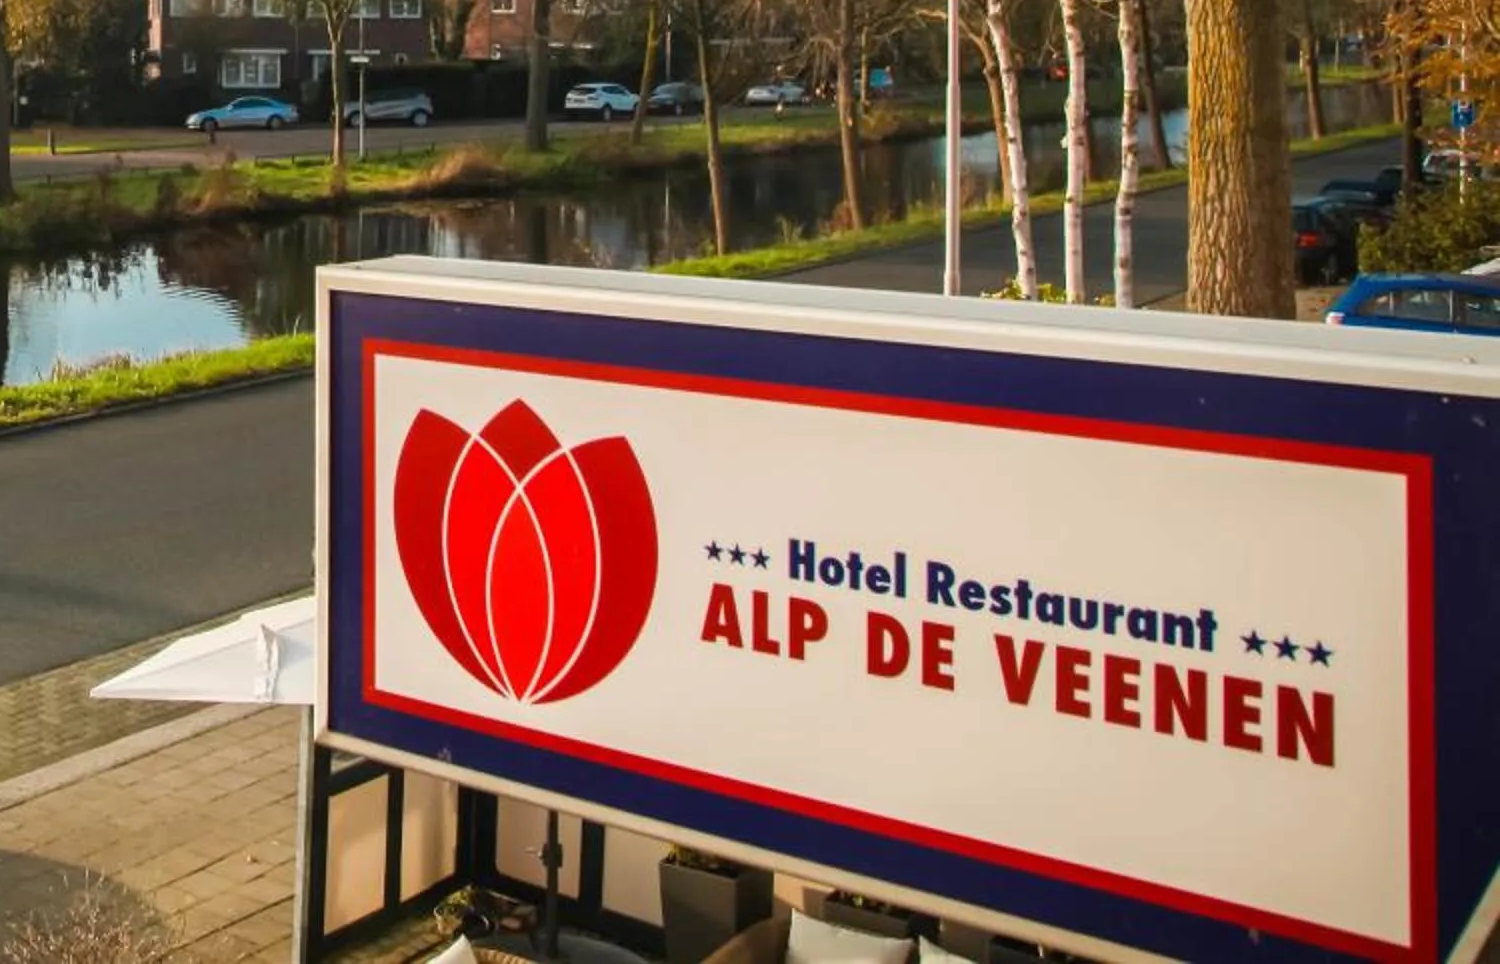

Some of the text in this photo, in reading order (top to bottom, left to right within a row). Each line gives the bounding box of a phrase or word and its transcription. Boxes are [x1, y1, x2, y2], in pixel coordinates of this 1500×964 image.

[788, 537, 1219, 653] Hotel Restaurant
[700, 582, 1336, 768] ALP DE VEENEN
